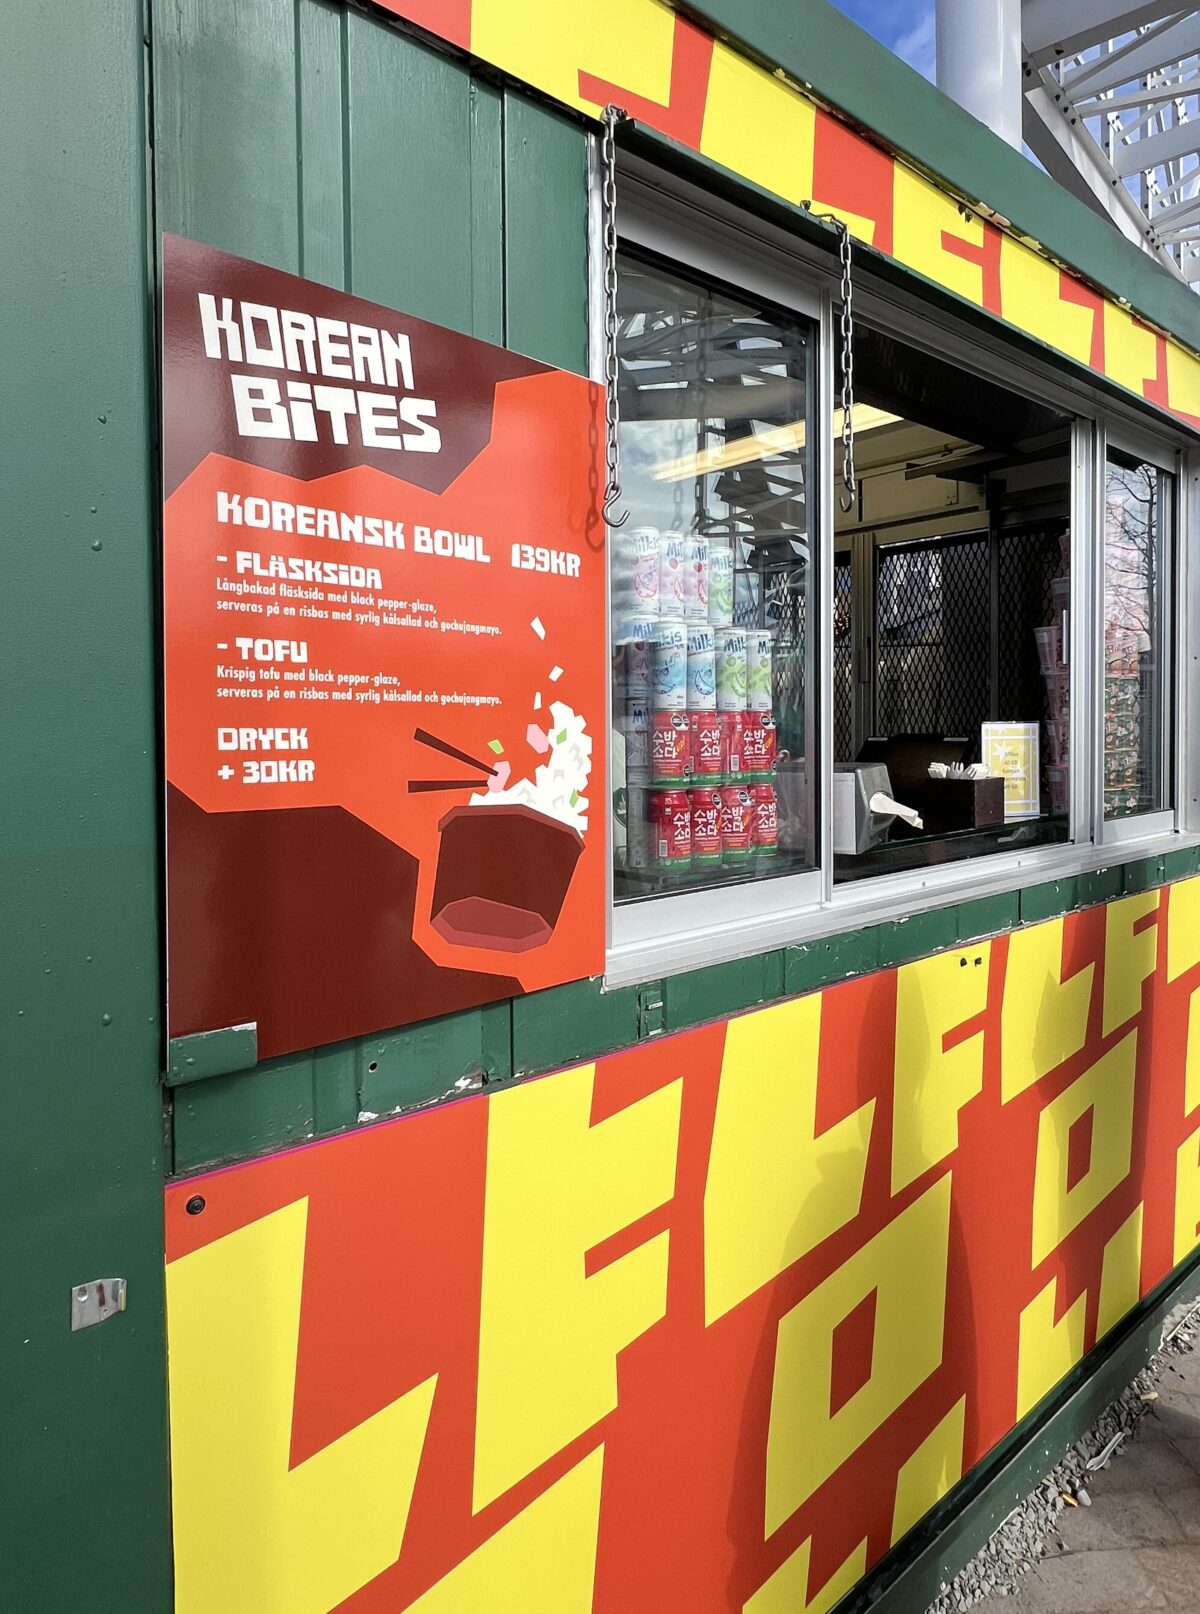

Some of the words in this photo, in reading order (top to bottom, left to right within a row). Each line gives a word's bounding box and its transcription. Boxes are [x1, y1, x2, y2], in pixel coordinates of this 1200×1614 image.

[198, 293, 414, 390] KOREAN
[217, 492, 405, 549] KOREANSK
[414, 526, 490, 562] BOWL
[512, 544, 580, 577] 139KR
[217, 578, 275, 595] Långbakad
[280, 584, 324, 600] fläsksida
[328, 591, 347, 602] med
[351, 592, 374, 605] black
[378, 599, 437, 613] pepper-glaze,
[217, 601, 262, 613] serveras
[267, 602, 279, 616] på
[284, 607, 295, 615] en
[300, 605, 328, 618] risbas
[332, 609, 352, 620] med
[355, 611, 380, 626] syrlig
[383, 612, 421, 627] kålsallad
[425, 617, 438, 628] och
[441, 620, 501, 636] gochujangmayo.
[236, 638, 307, 662] TOFU
[217, 665, 255, 682] Krispig
[260, 667, 280, 680] tofu
[284, 669, 305, 680] med
[309, 669, 334, 681] black
[338, 672, 400, 687] pepper-glaze,
[217, 688, 263, 697] serveras
[267, 686, 279, 701] på
[300, 687, 328, 699] risbas
[332, 688, 352, 700] med
[356, 689, 380, 703] syrlig
[384, 689, 422, 701] kålsallad
[425, 691, 438, 702] och
[441, 692, 501, 706] gochujangmayo.
[218, 728, 308, 750] DRYCK
[218, 765, 234, 779] +
[243, 760, 315, 783] 30KR
